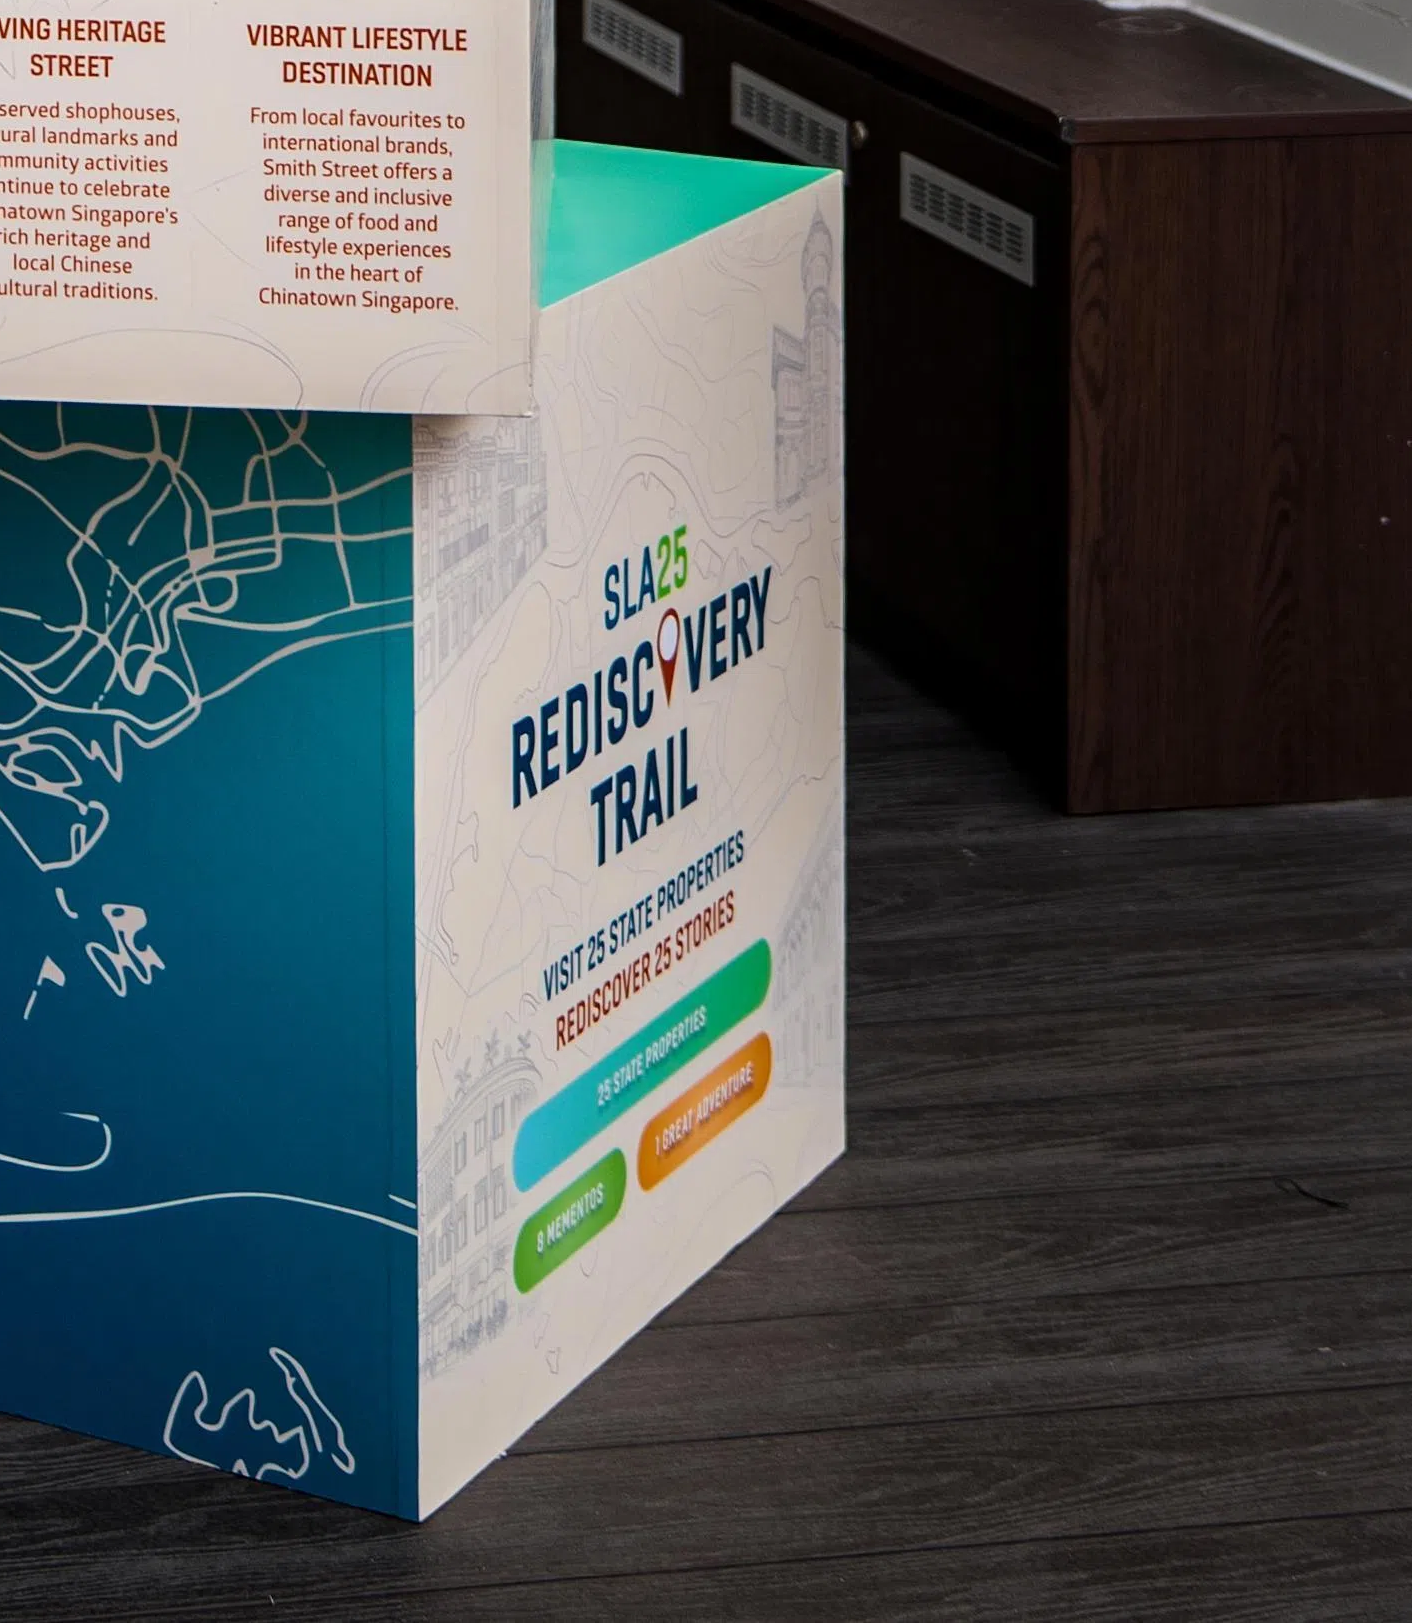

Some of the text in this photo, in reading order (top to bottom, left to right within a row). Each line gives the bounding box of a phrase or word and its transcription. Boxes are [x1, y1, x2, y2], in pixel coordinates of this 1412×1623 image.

[57, 18, 166, 44] HERITAGE
[246, 24, 468, 52] VIBRANT LIFESTYLE
[30, 53, 114, 78] STREET
[282, 61, 432, 87] DESTINATION
[65, 101, 180, 124] shophouses,
[250, 106, 466, 130] From local favourites to
[42, 126, 139, 147] landmarks
[144, 130, 178, 148] and
[263, 135, 453, 157] international brands,
[603, 523, 689, 631] SLA25
[590, 726, 698, 868] TRAIL
[543, 828, 745, 1002] VISIT 25 STATE PROPERTIES
[555, 889, 735, 1052] REDISCOVER 25 STORIES
[597, 1005, 707, 1106] 25 STATE PROPERTIES
[662, 1108, 694, 1151] GREAT
[695, 1060, 754, 1125] ADVENTURE
[536, 1181, 605, 1254] 8 MEMENTOS
